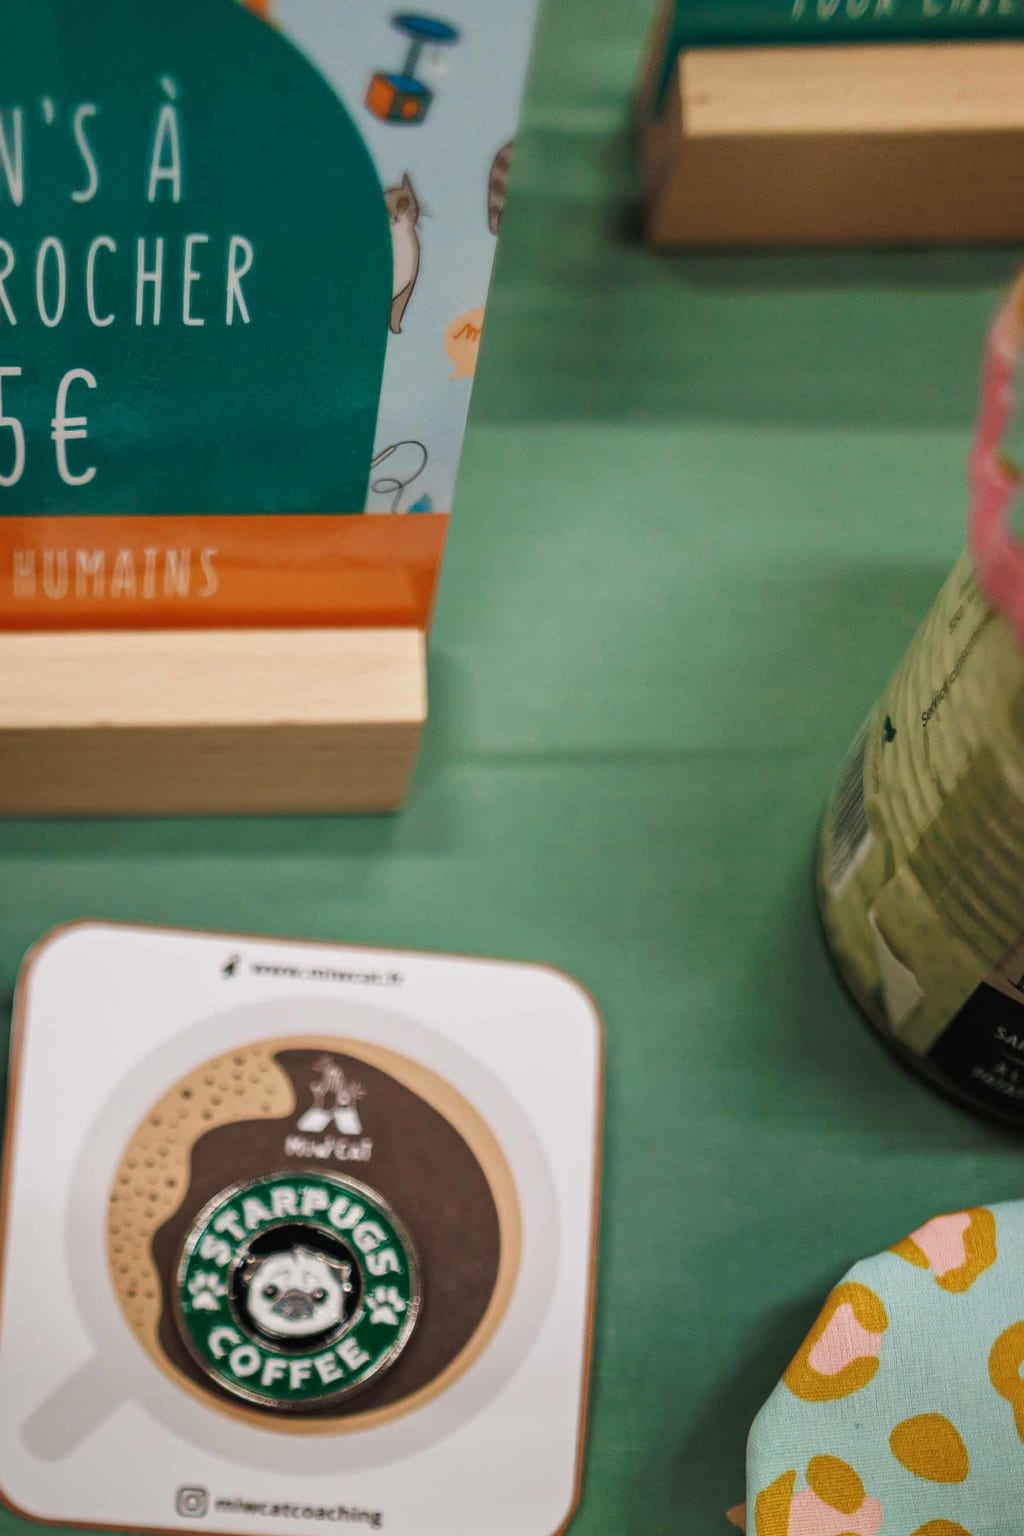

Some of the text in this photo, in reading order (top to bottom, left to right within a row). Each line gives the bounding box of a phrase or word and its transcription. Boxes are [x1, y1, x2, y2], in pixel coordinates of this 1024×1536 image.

[149, 76, 183, 205] À
[12, 546, 221, 600] HUMAINS
[250, 959, 405, 988] www.miwcat.fr
[200, 1186, 405, 1275] STARPUGS
[207, 1326, 370, 1389] COFFEE
[215, 1496, 382, 1528] miwcatcoaching
